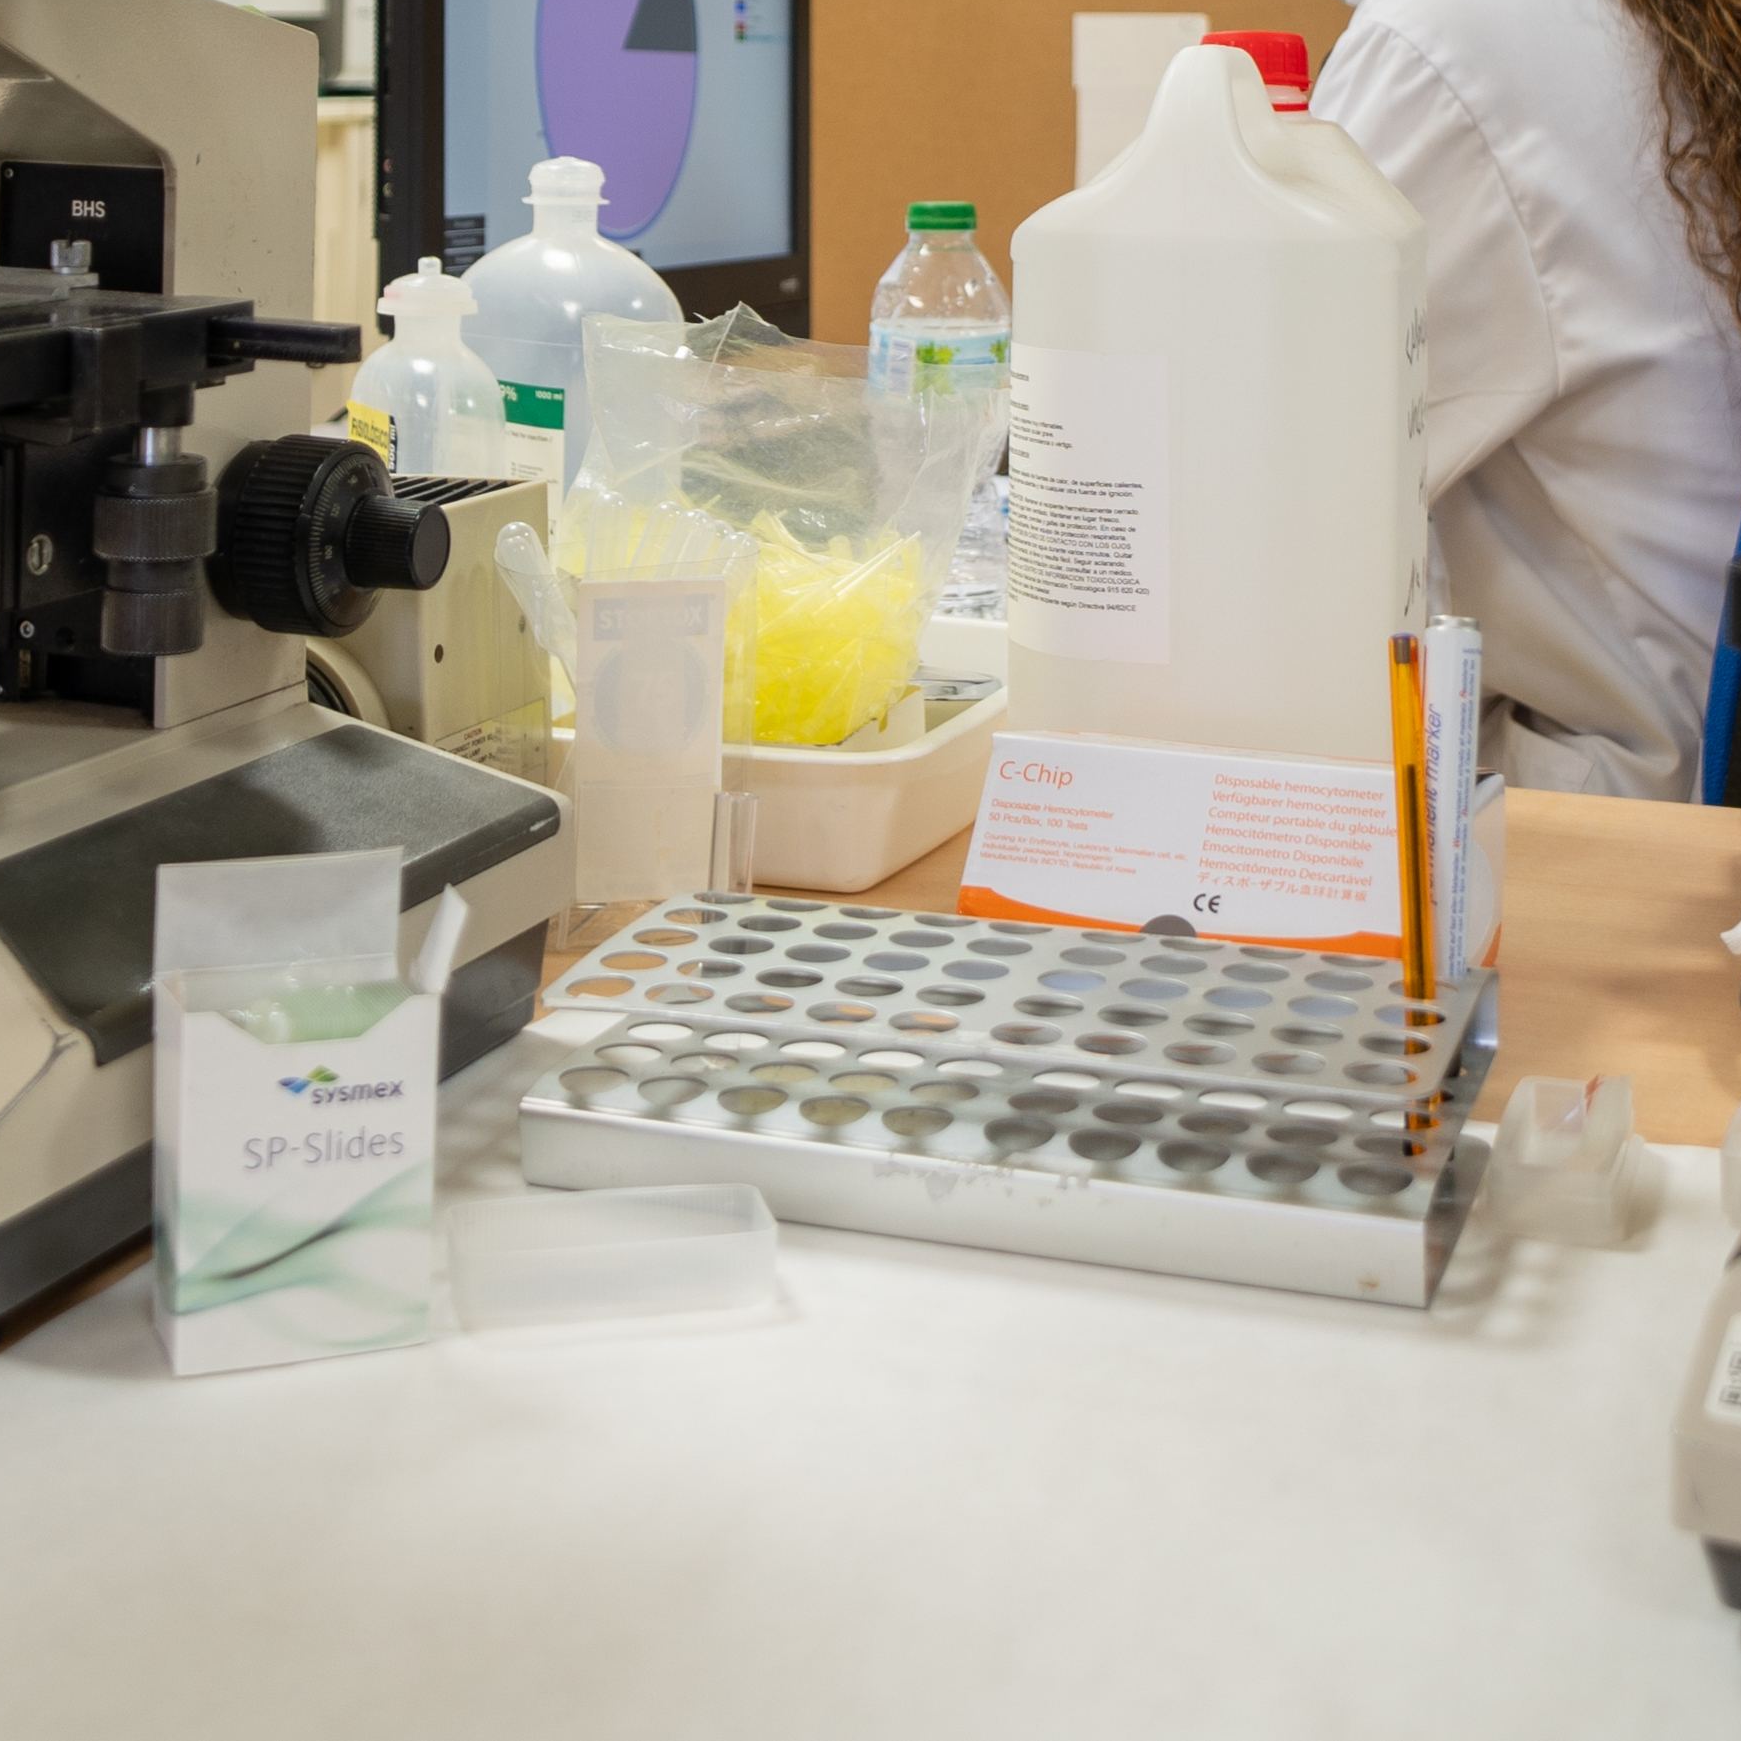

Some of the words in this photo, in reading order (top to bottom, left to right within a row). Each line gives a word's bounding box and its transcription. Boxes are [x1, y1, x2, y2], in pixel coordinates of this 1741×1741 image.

[71, 199, 106, 218] BHS
[999, 760, 1074, 790] C-Chip
[1214, 773, 1283, 793] Disposable
[1283, 780, 1385, 803] hemocytometer
[1211, 790, 1285, 809] Verfügbarer
[1285, 797, 1387, 820] hemocytometer
[988, 811, 1000, 822] 50
[1046, 817, 1062, 828] 100
[1208, 806, 1271, 825] Compteur
[1272, 813, 1327, 831] portable
[1327, 819, 1346, 832] du
[1304, 833, 1373, 853] Disponible
[312, 1080, 404, 1105] sysmex
[243, 1125, 405, 1171] SP-Slides
